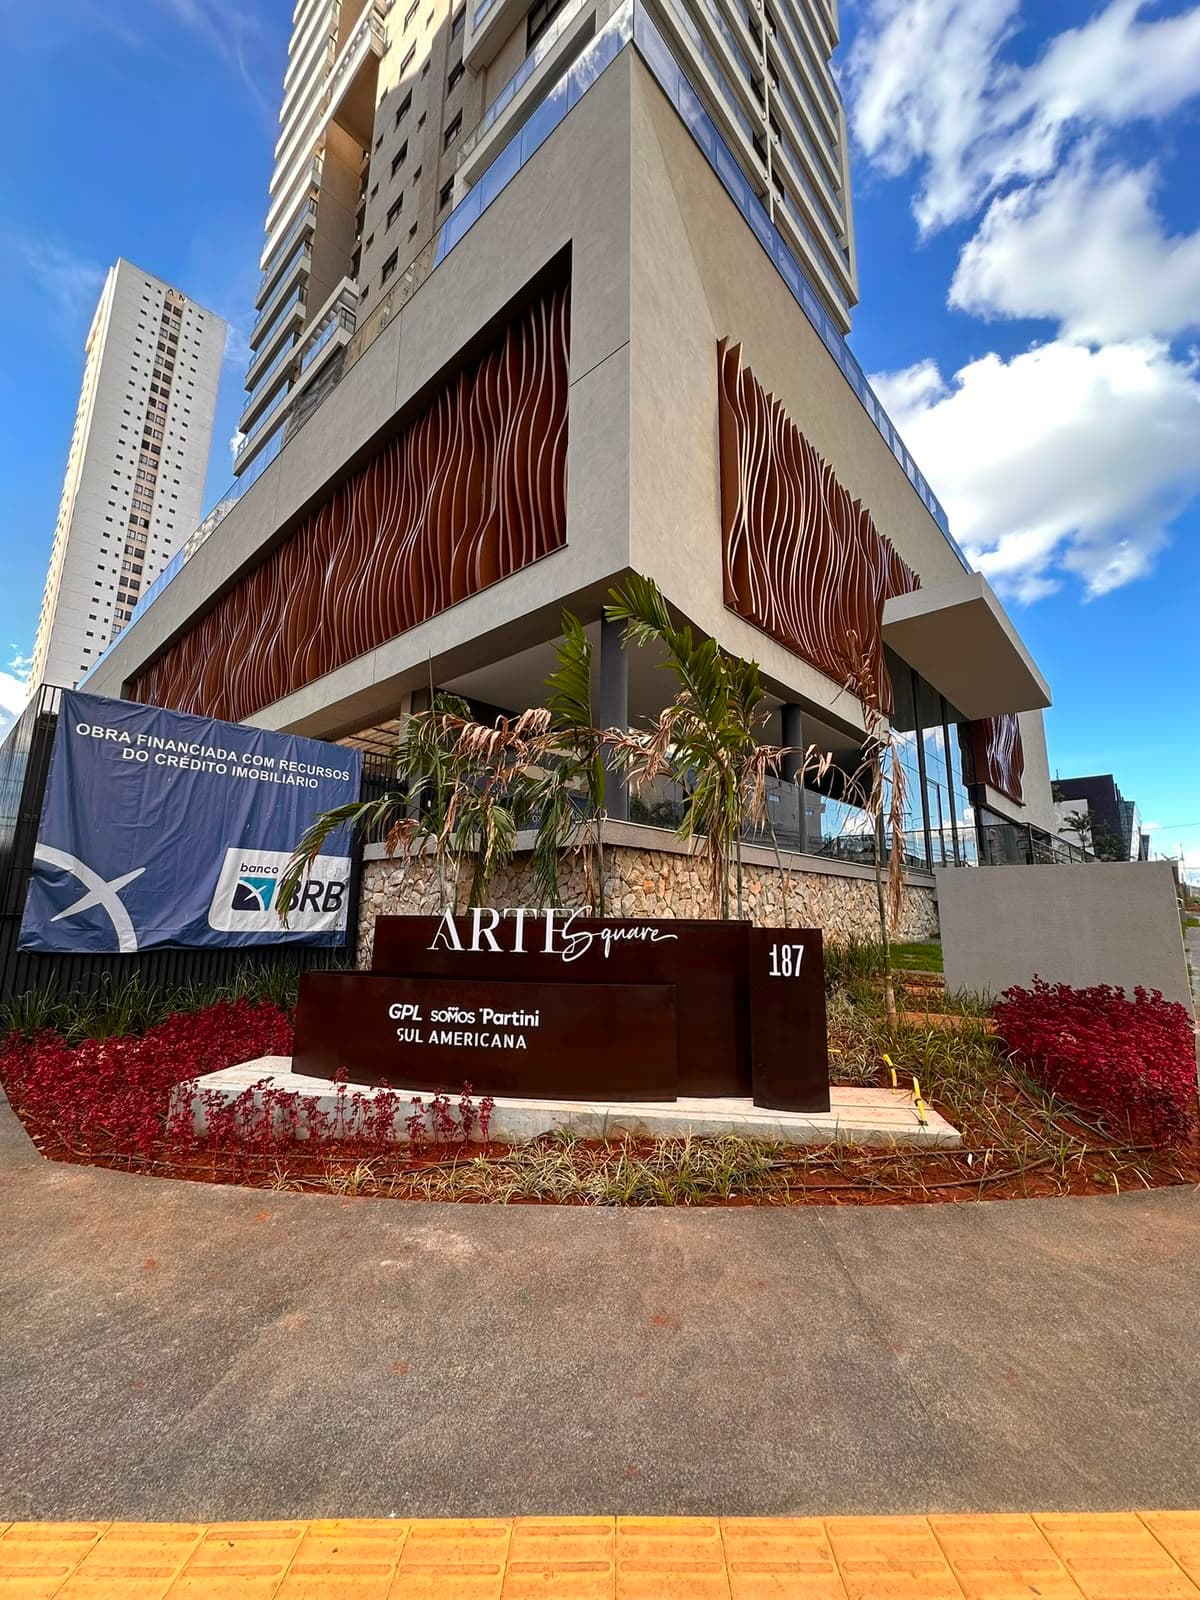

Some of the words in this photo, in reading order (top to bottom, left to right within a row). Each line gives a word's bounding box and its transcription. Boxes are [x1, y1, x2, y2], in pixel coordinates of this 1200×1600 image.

[76, 723, 131, 743] OBRA
[137, 733, 238, 762] FINANCIADA
[242, 753, 275, 769] COM
[279, 759, 350, 781] RECURSOS
[122, 747, 149, 762] DO
[154, 754, 227, 775] CRÉDITO
[231, 766, 319, 789] IMOBILIÁRIO
[240, 863, 279, 874] banco
[427, 904, 575, 954] ARTE
[561, 905, 678, 962] Square
[768, 944, 804, 977] 187
[388, 1003, 423, 1021] GPL
[396, 1028, 424, 1043] SUL
[428, 1030, 527, 1049] AMERICANA
